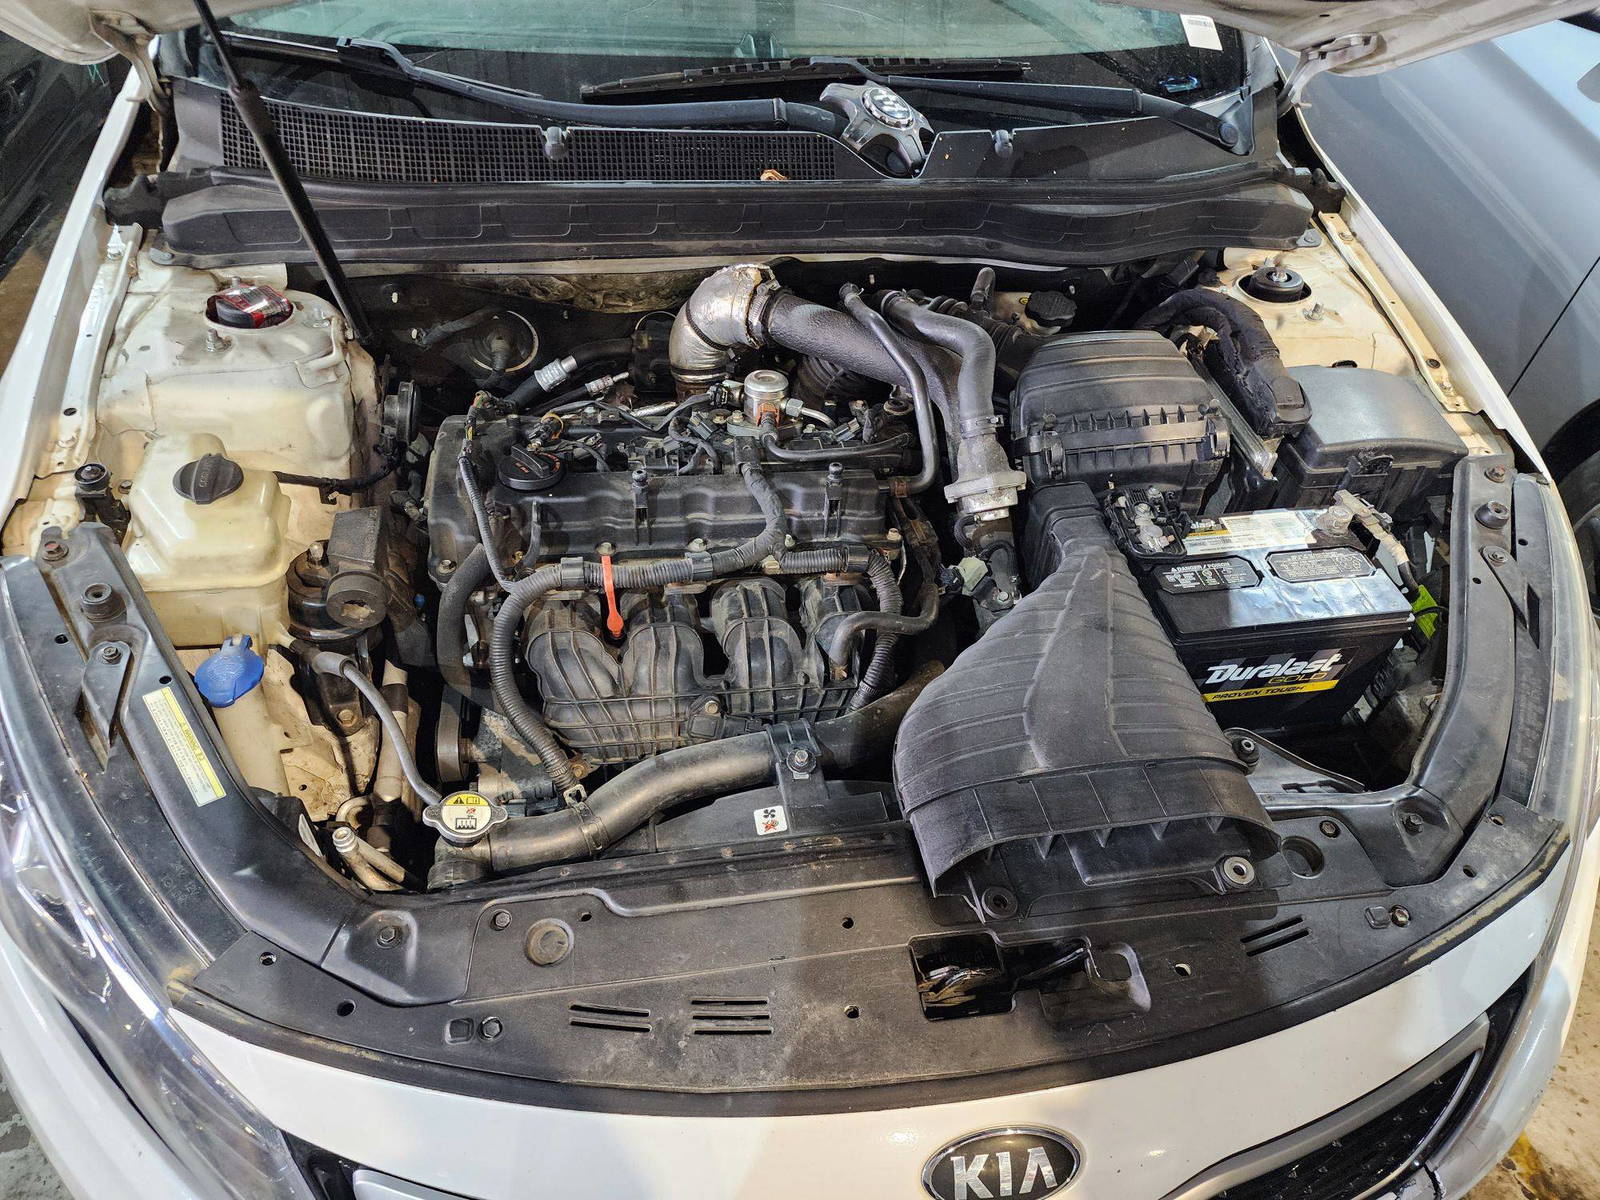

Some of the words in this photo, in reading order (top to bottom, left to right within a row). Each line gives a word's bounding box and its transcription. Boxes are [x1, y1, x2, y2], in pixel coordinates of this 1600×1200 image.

[1205, 653, 1343, 684] Duralast
[1268, 672, 1328, 684] GOLD
[1211, 690, 1261, 700] PROVEN
[1265, 686, 1305, 694] TOUGH
[950, 1146, 1058, 1200] KIA
